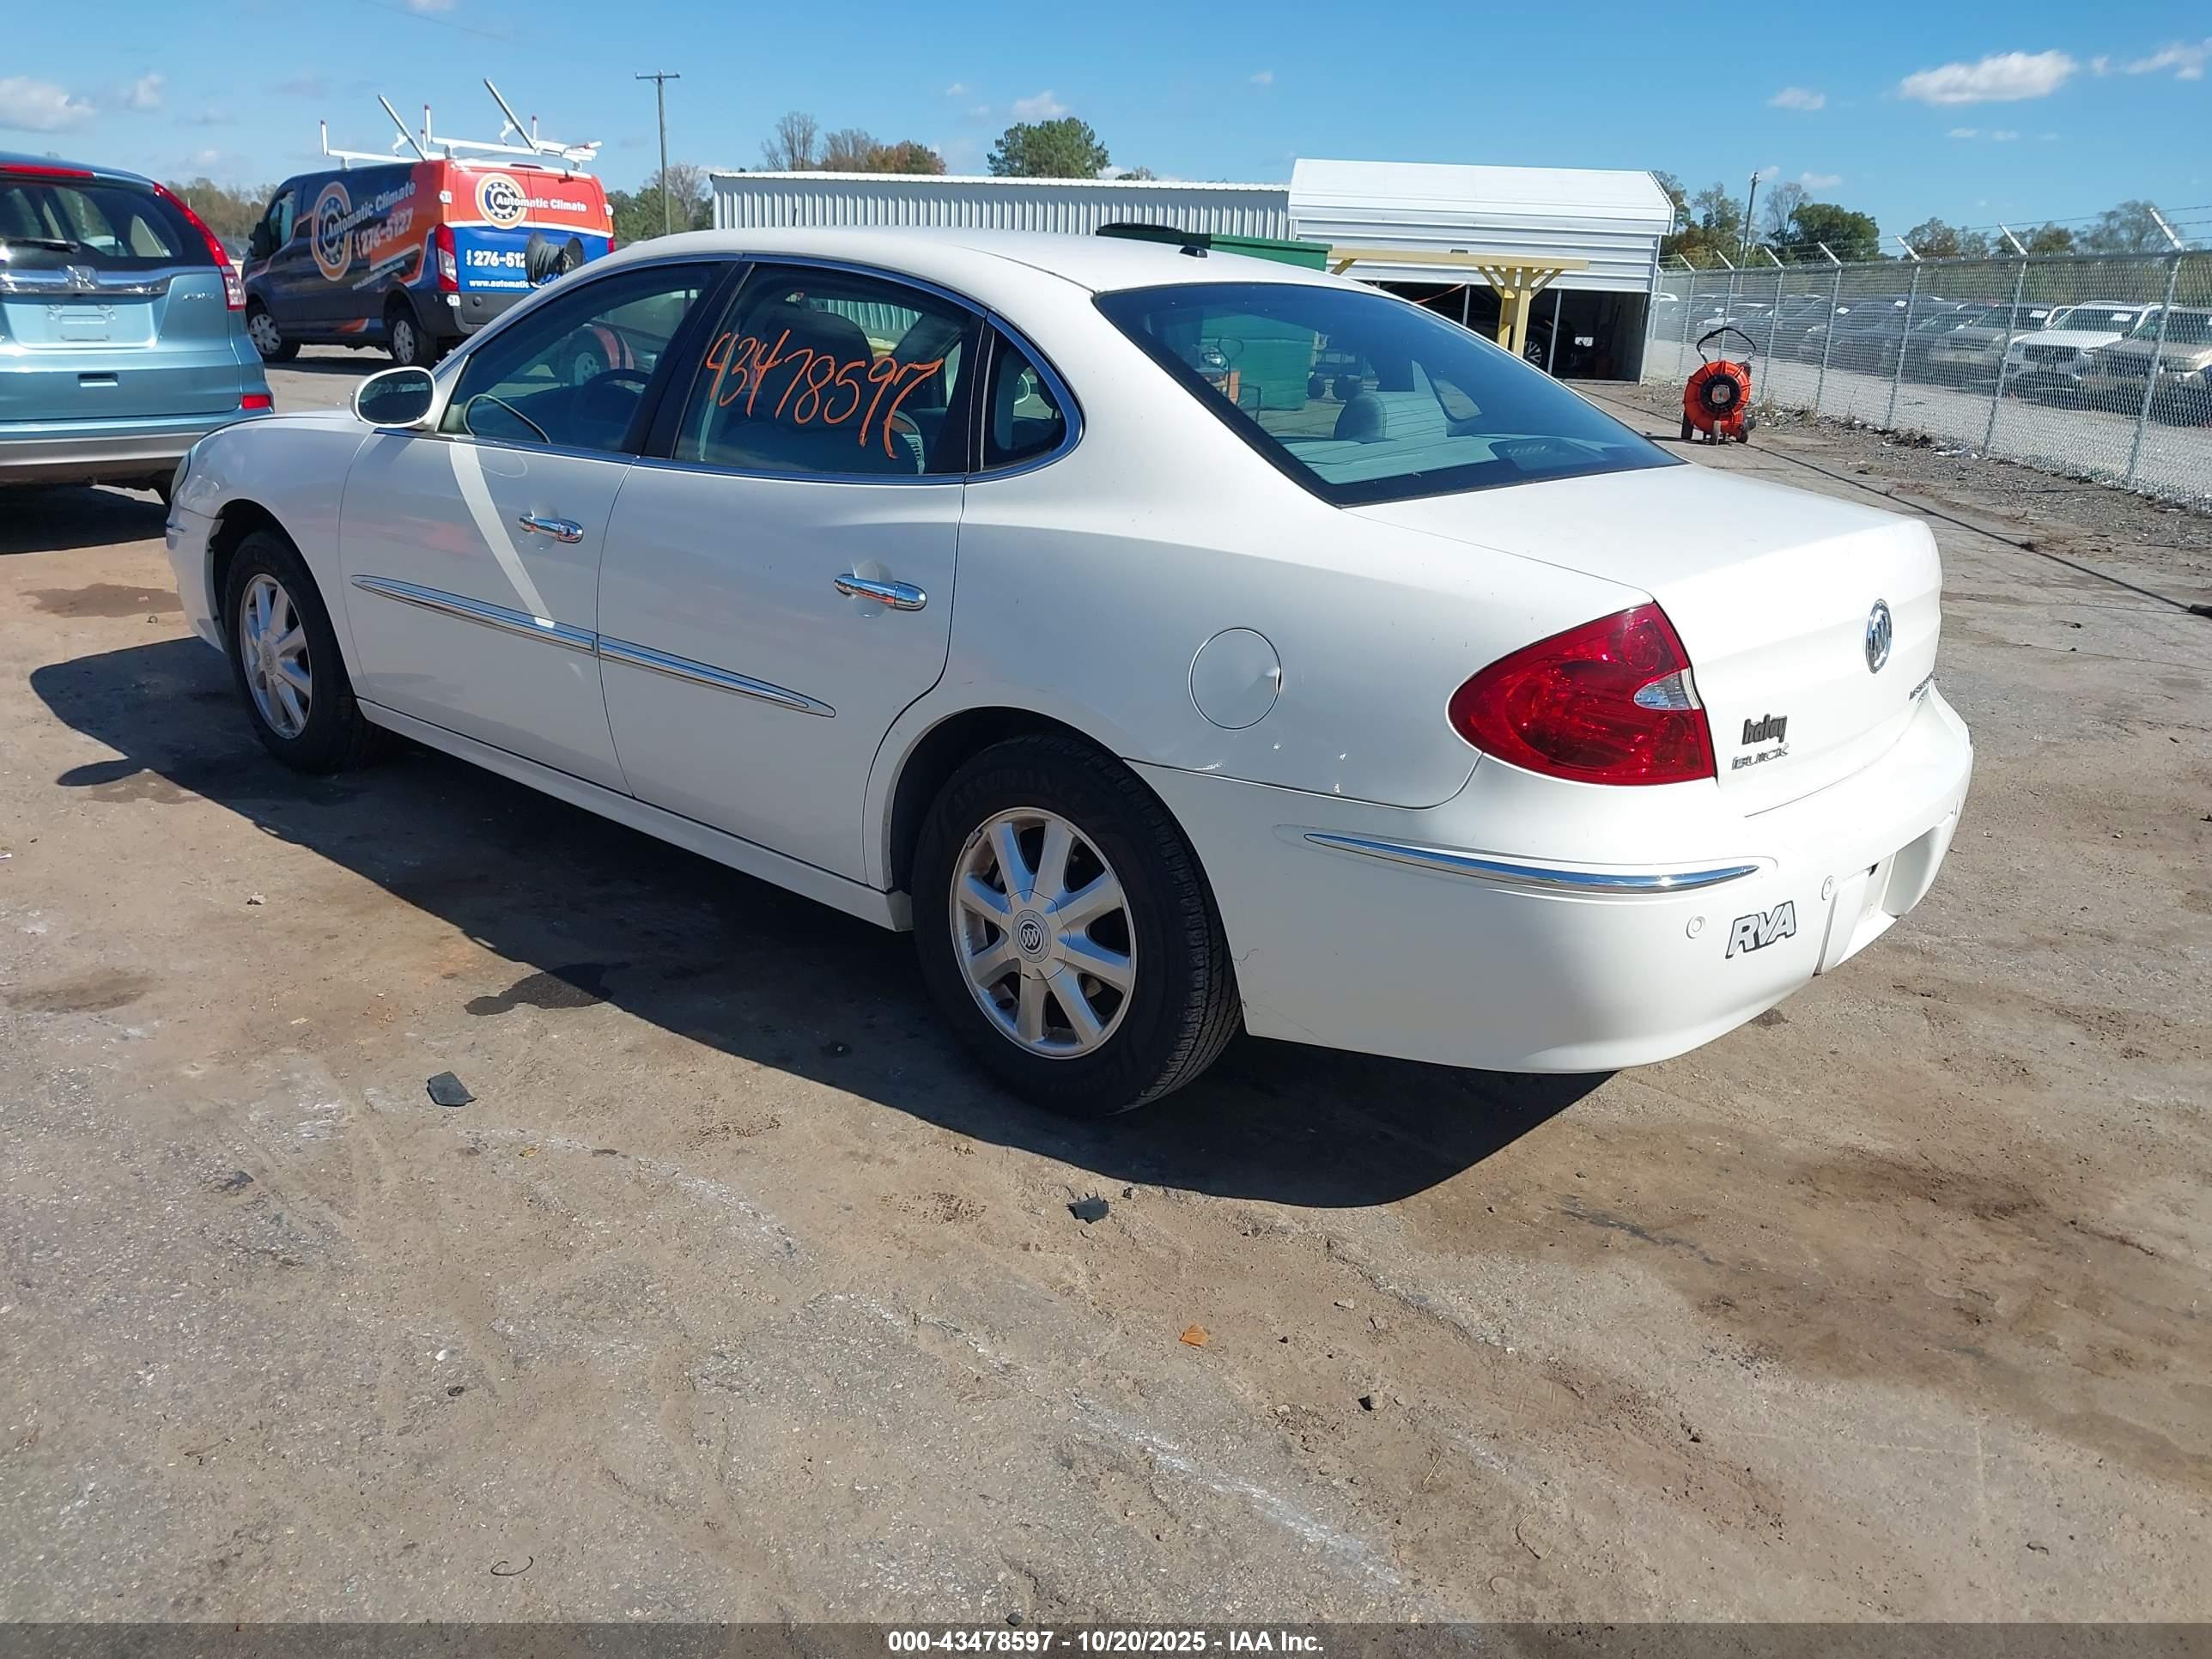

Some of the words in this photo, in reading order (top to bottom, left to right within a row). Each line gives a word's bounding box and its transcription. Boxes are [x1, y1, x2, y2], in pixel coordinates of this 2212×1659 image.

[329, 201, 374, 238] Automatic
[375, 181, 416, 212] Climate
[495, 194, 550, 209] Automatic
[550, 198, 587, 212] Climate
[360, 207, 413, 256] 276-5127
[473, 250, 526, 268] 276-512
[706, 329, 945, 459] 43478597
[1730, 742, 1790, 771] BUICK
[1725, 900, 1796, 960] RVA
